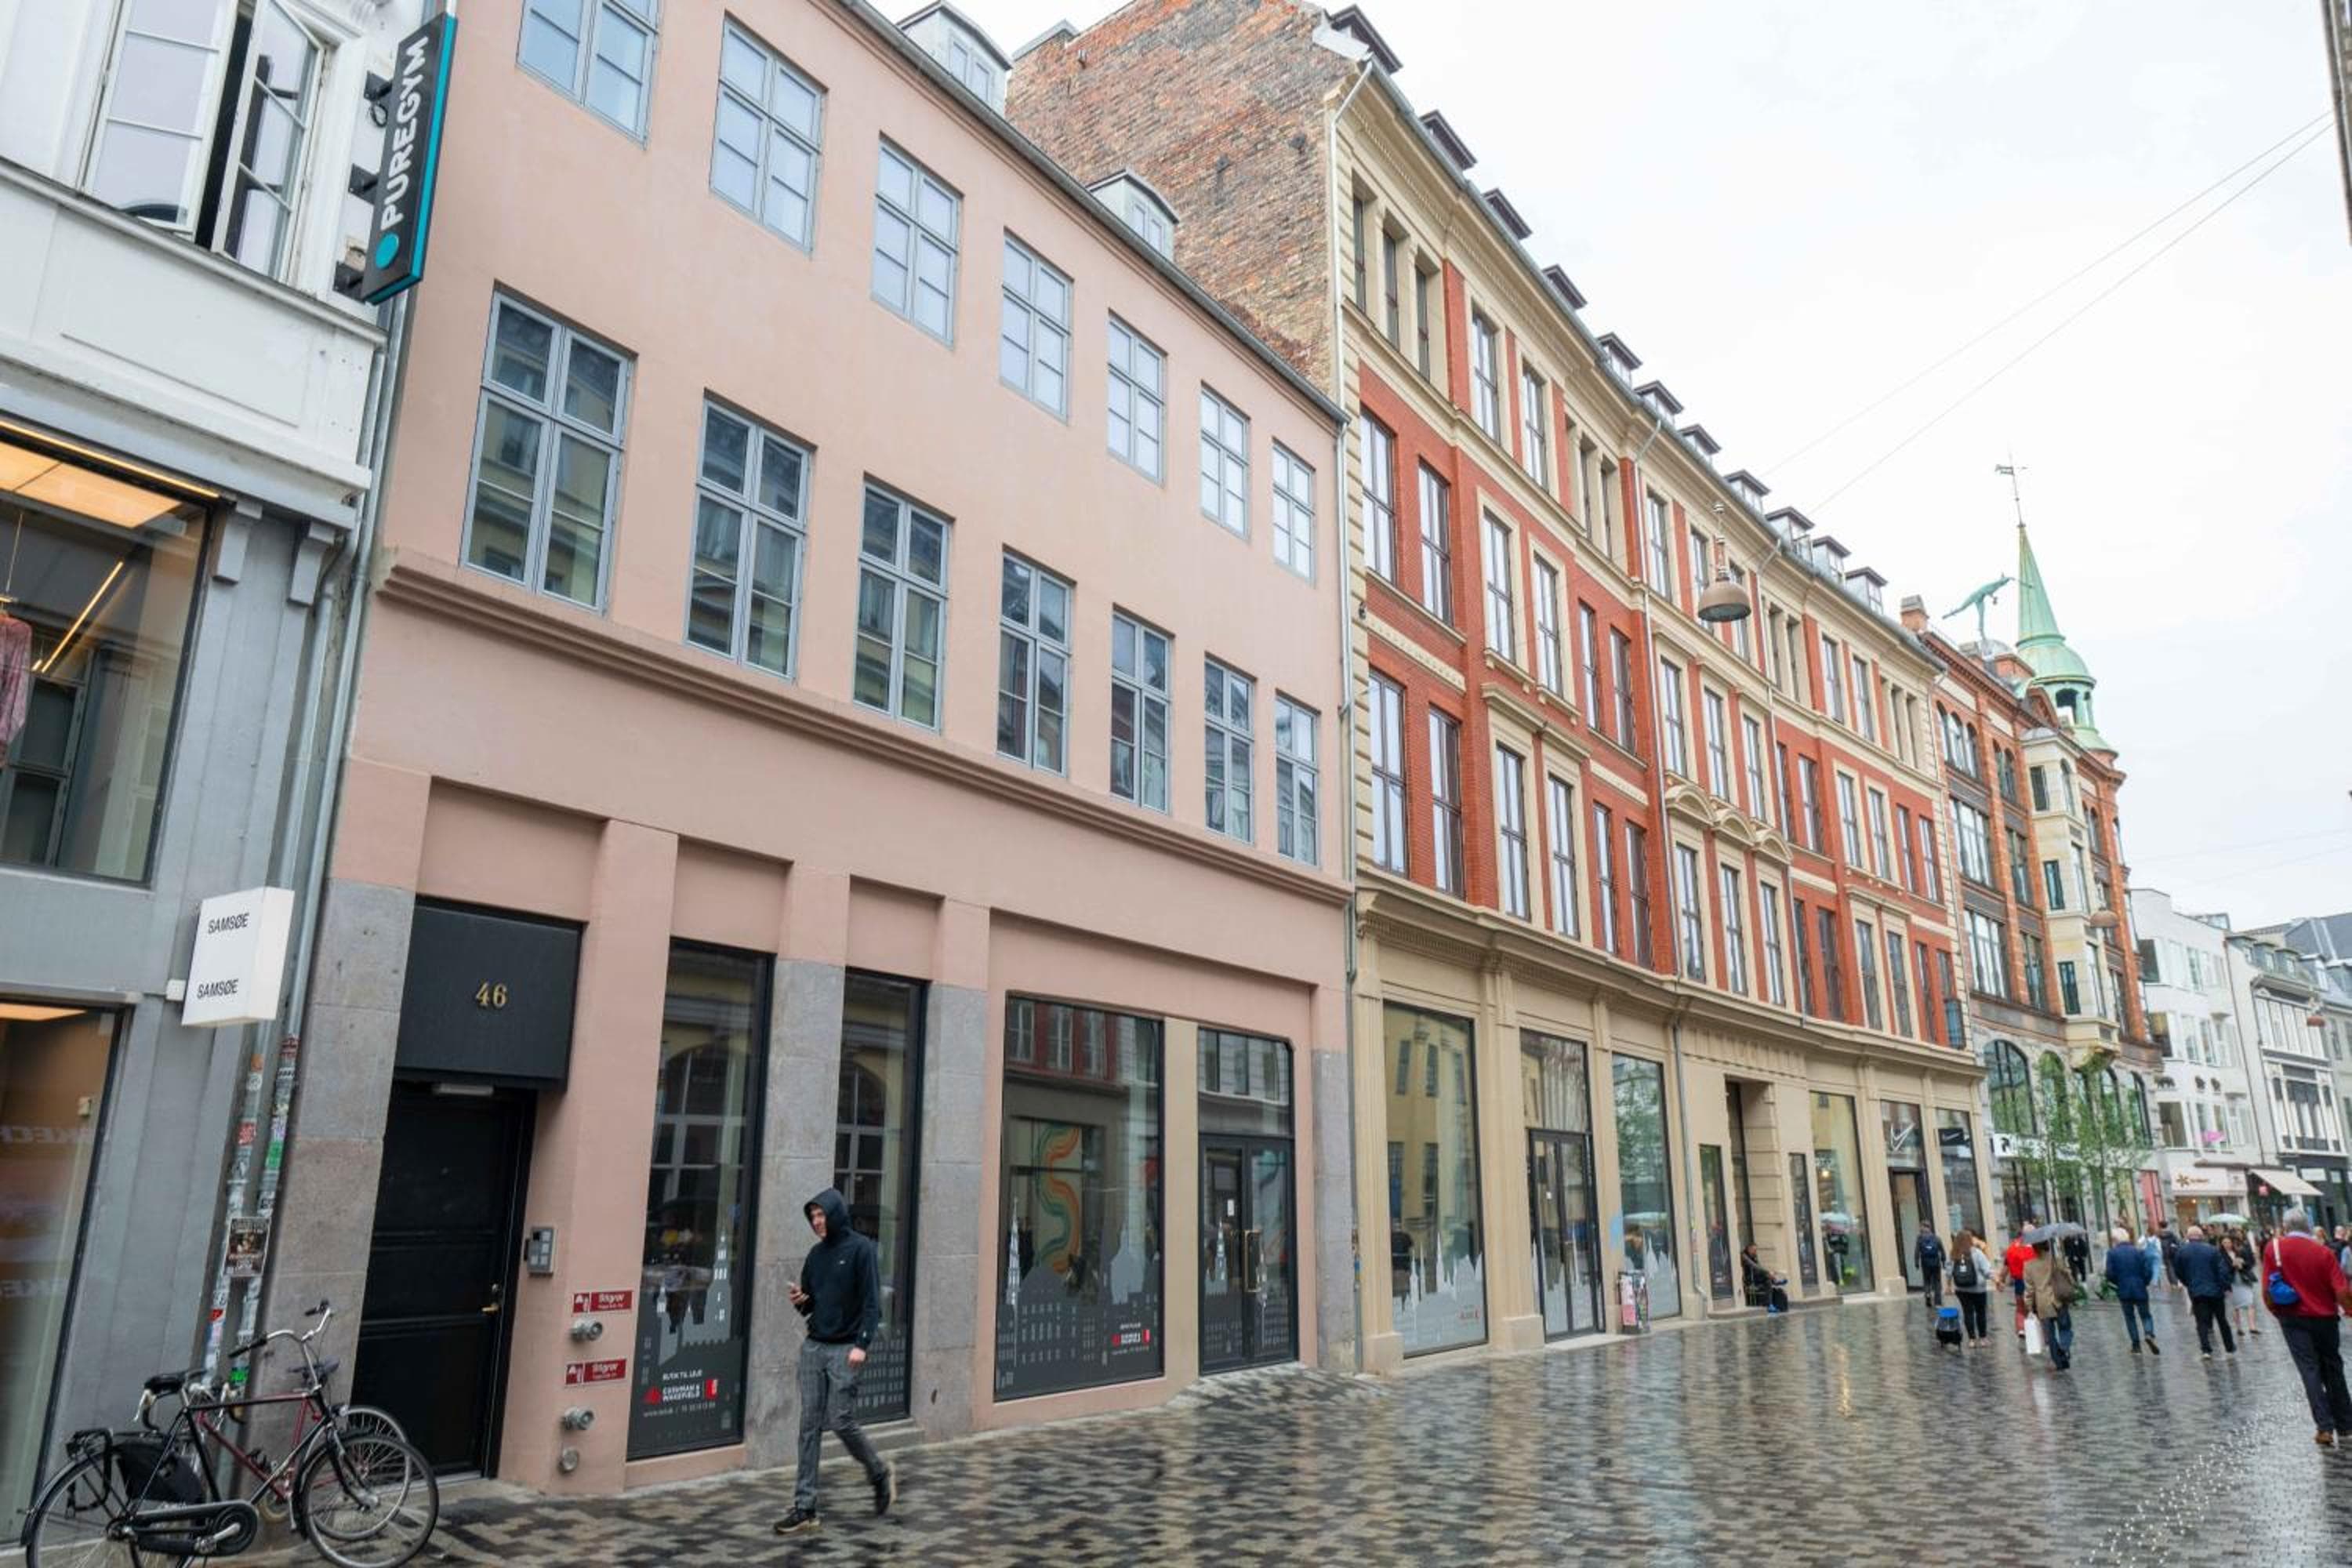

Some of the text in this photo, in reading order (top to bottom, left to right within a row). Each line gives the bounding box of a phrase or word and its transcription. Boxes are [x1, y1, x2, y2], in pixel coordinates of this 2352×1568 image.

[380, 36, 429, 230] PUREGYM
[208, 913, 249, 934] SAMSØE
[197, 978, 239, 1000] SAMSØE
[476, 982, 506, 1007] 46
